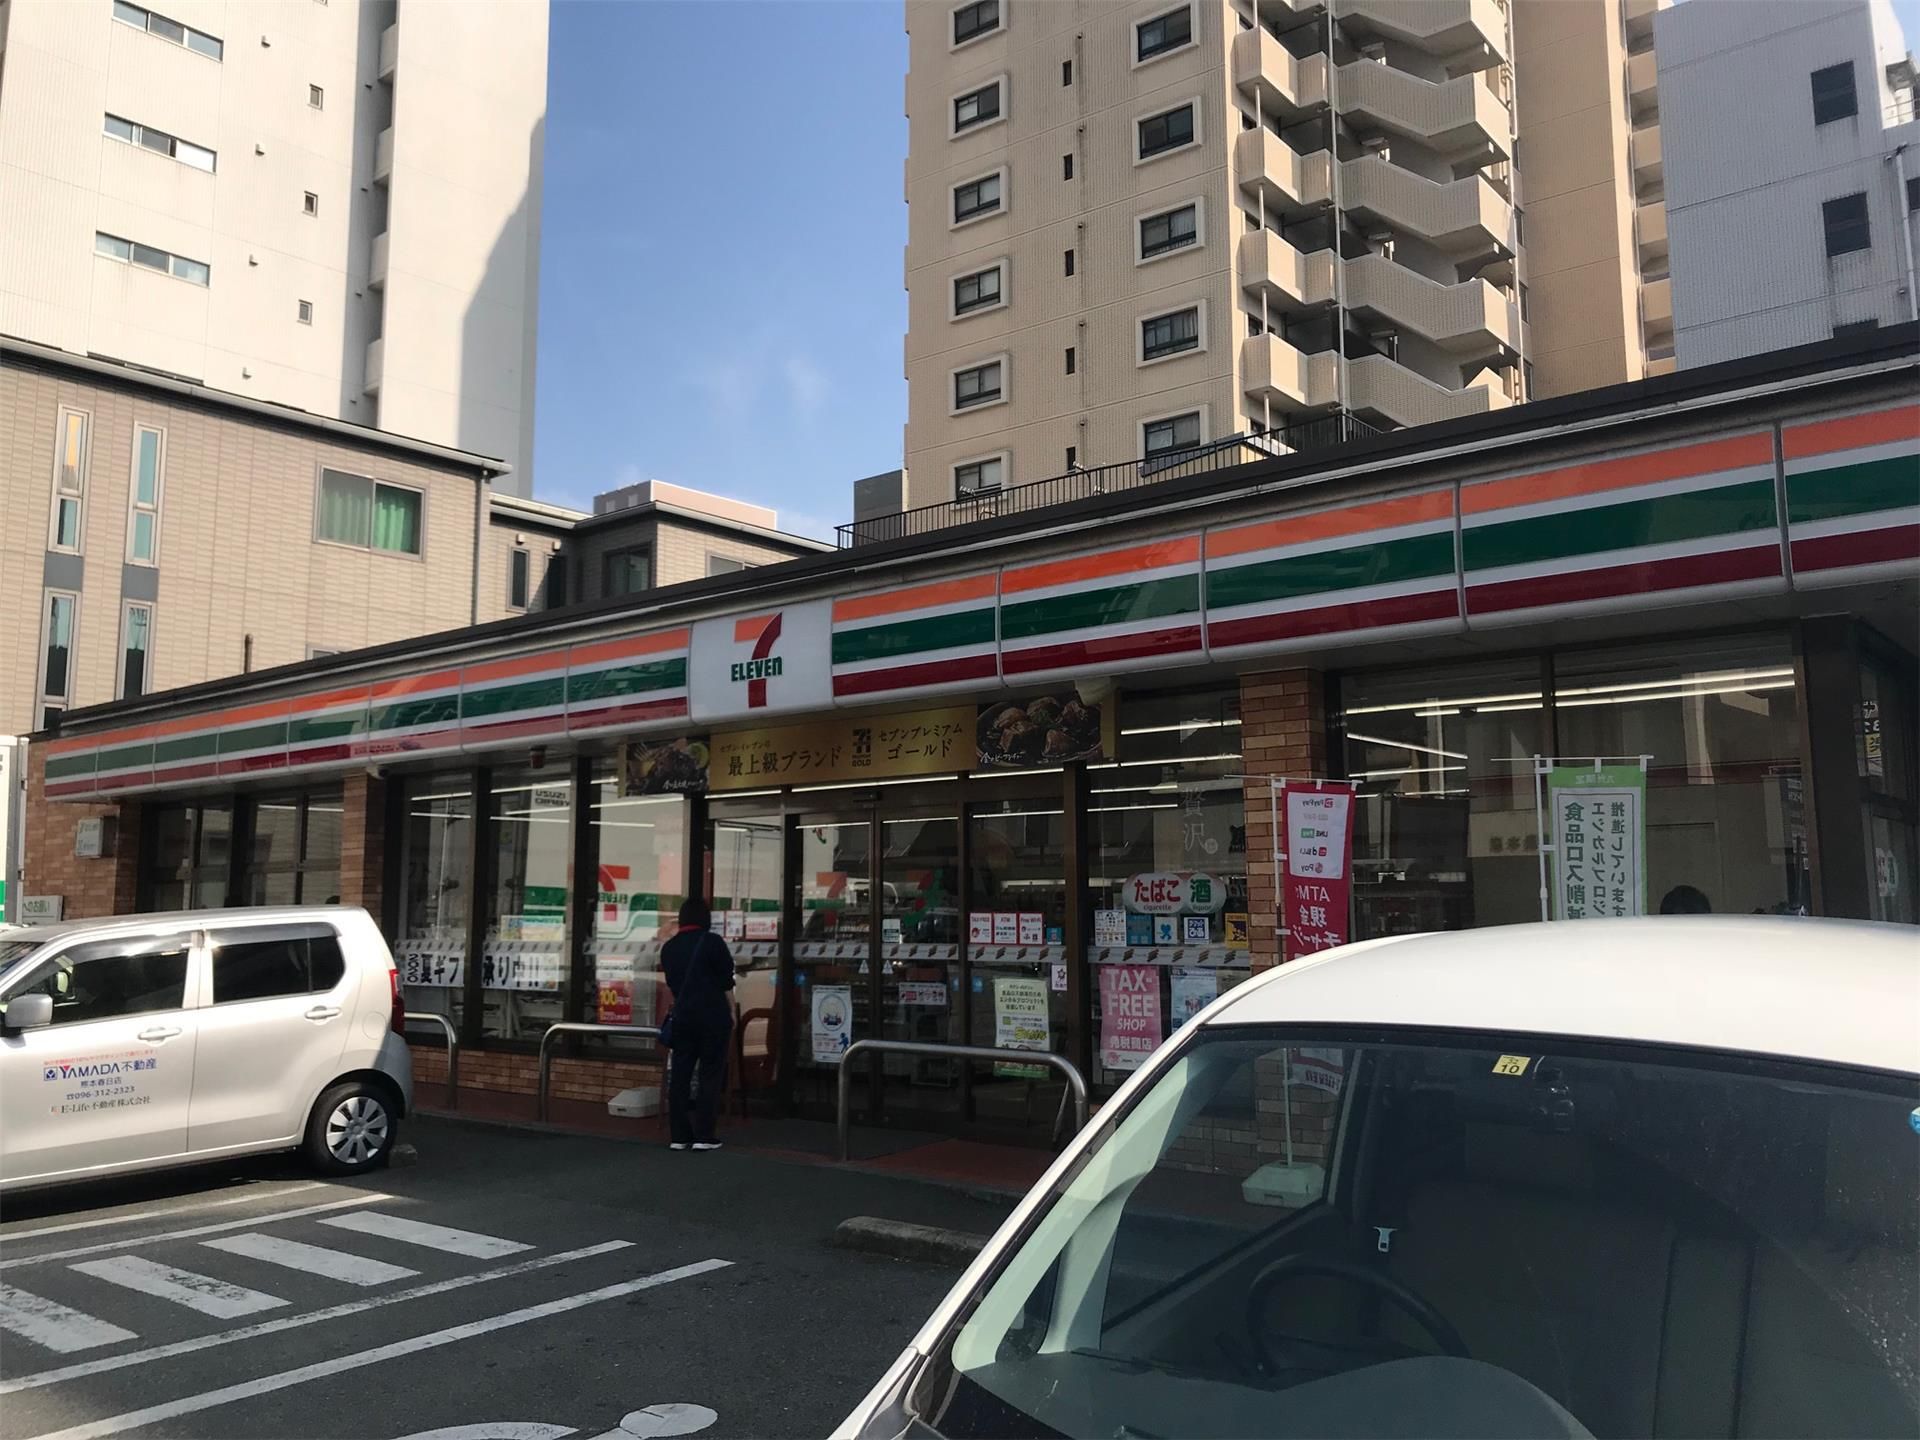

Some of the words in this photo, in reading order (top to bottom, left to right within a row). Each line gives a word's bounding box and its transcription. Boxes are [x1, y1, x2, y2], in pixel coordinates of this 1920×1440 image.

[734, 612, 783, 708] 7
[878, 722, 963, 742] セブンプレミアム
[887, 739, 953, 760] ゴールド
[727, 747, 842, 777] 最上級ブランド
[1134, 879, 1181, 903] たばこ
[1190, 878, 1211, 903] 酒
[1105, 968, 1152, 992] TAX-
[1108, 995, 1154, 1017] FREE
[1117, 1017, 1146, 1031] SHOP
[1500, 1065, 1520, 1074] 10
